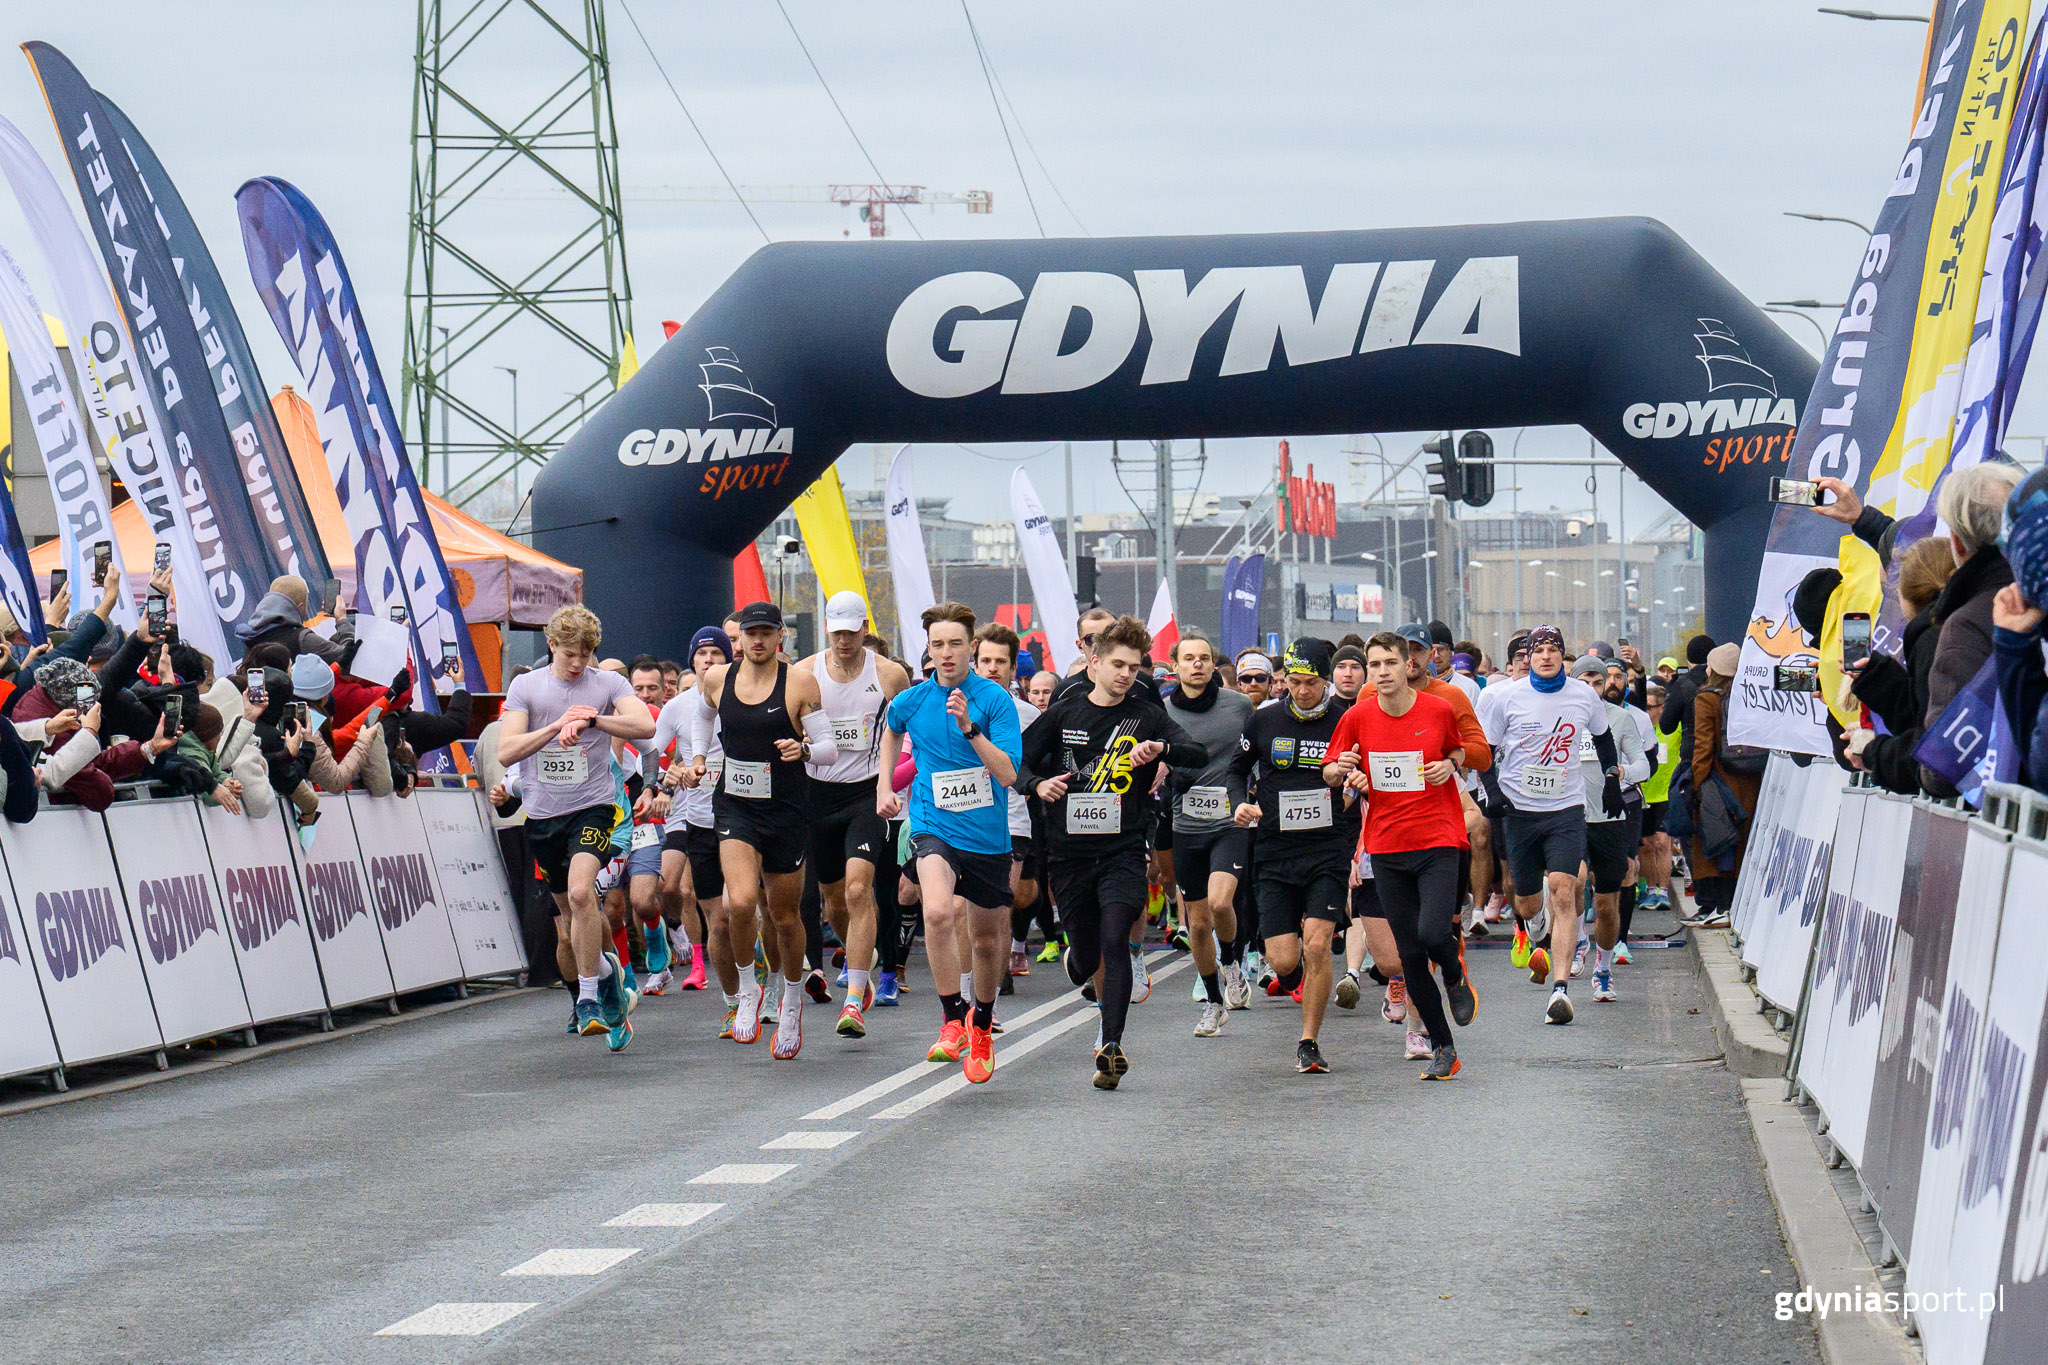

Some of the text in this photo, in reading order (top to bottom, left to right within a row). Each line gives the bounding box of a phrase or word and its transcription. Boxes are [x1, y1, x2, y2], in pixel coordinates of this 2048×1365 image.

[886, 256, 1521, 399] GDYNIA
[1622, 398, 1797, 439] GDYNIA
[618, 427, 793, 467] GDYNIA
[1703, 428, 1796, 473] sport
[700, 455, 791, 500] sport
[833, 728, 858, 741] 568
[1299, 746, 1328, 759] 202
[543, 760, 576, 773] 2932
[1384, 766, 1402, 779] 50
[732, 773, 754, 786] 450
[1526, 775, 1556, 788] 2311
[941, 782, 978, 800] 2444
[1529, 788, 1551, 796] TOMASZ
[939, 797, 983, 809] MAKSYMILIAN
[1188, 797, 1220, 809] 3249
[1073, 807, 1108, 820] 4466
[1285, 806, 1322, 821] 4755
[633, 829, 646, 841] 24
[370, 853, 437, 932] GDYNIA
[225, 865, 300, 952] GDYNIA
[305, 860, 368, 942] GDYNIA
[138, 873, 219, 966] GDYNIA
[35, 886, 127, 983] GDYNIA
